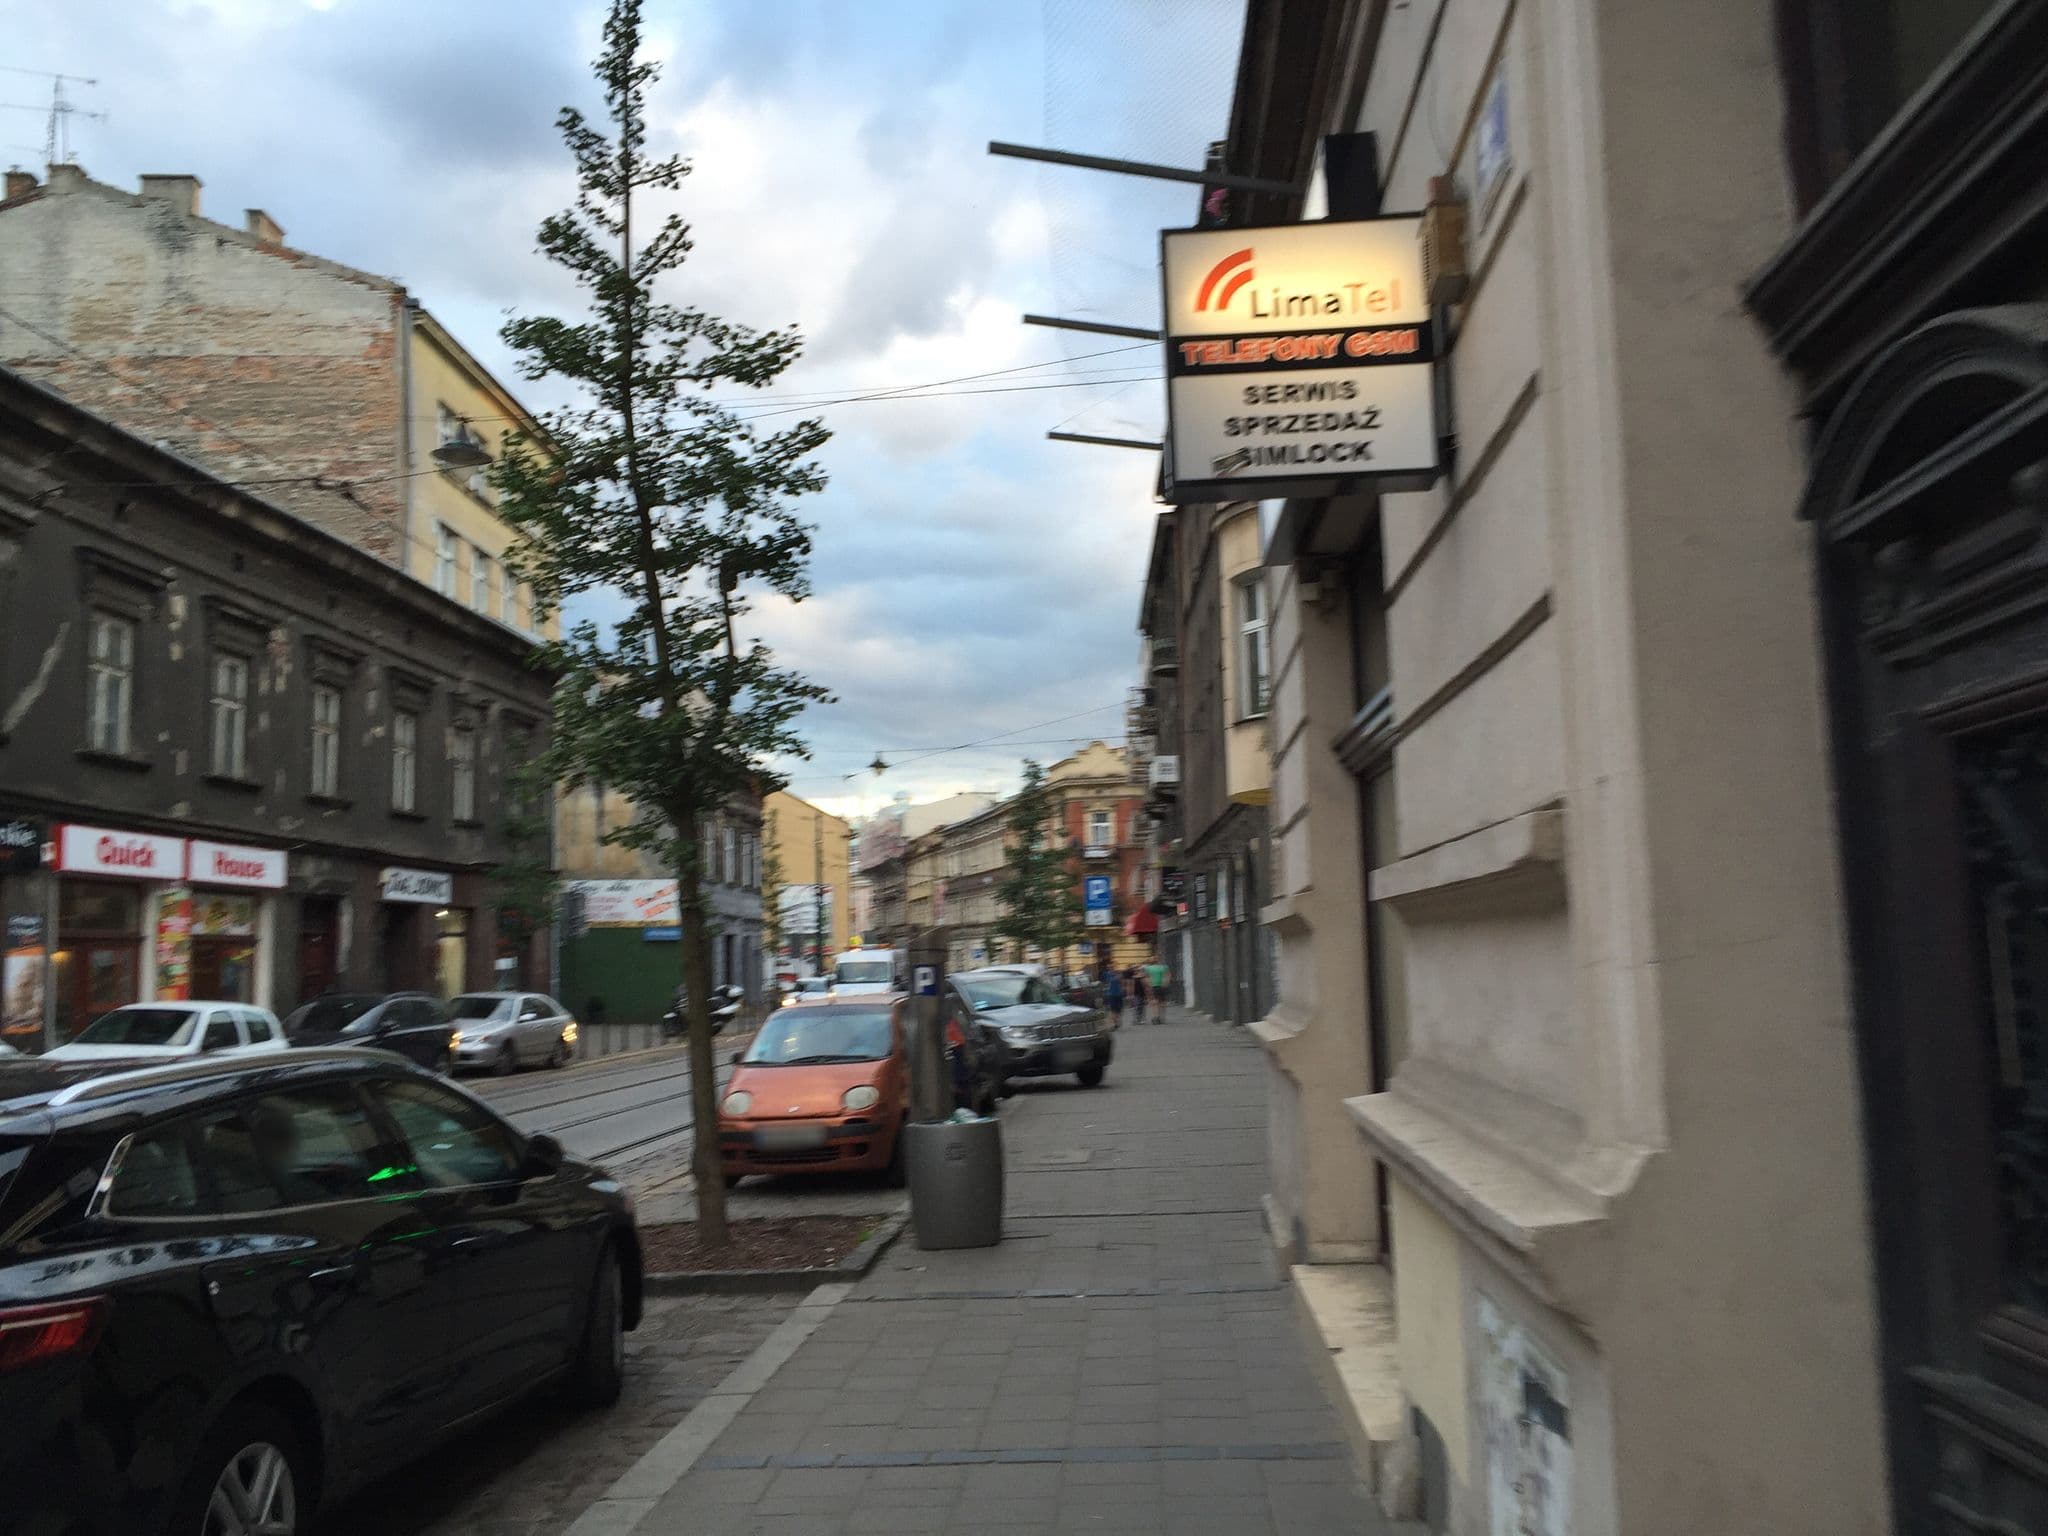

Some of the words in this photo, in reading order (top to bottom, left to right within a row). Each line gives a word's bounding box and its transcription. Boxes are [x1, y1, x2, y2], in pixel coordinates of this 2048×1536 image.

[1250, 279, 1401, 319] LimaTel
[1179, 335, 1343, 366] TELEFONY
[1344, 329, 1419, 358] GSM
[1243, 380, 1358, 404] SERWIS
[914, 966, 935, 994] P
